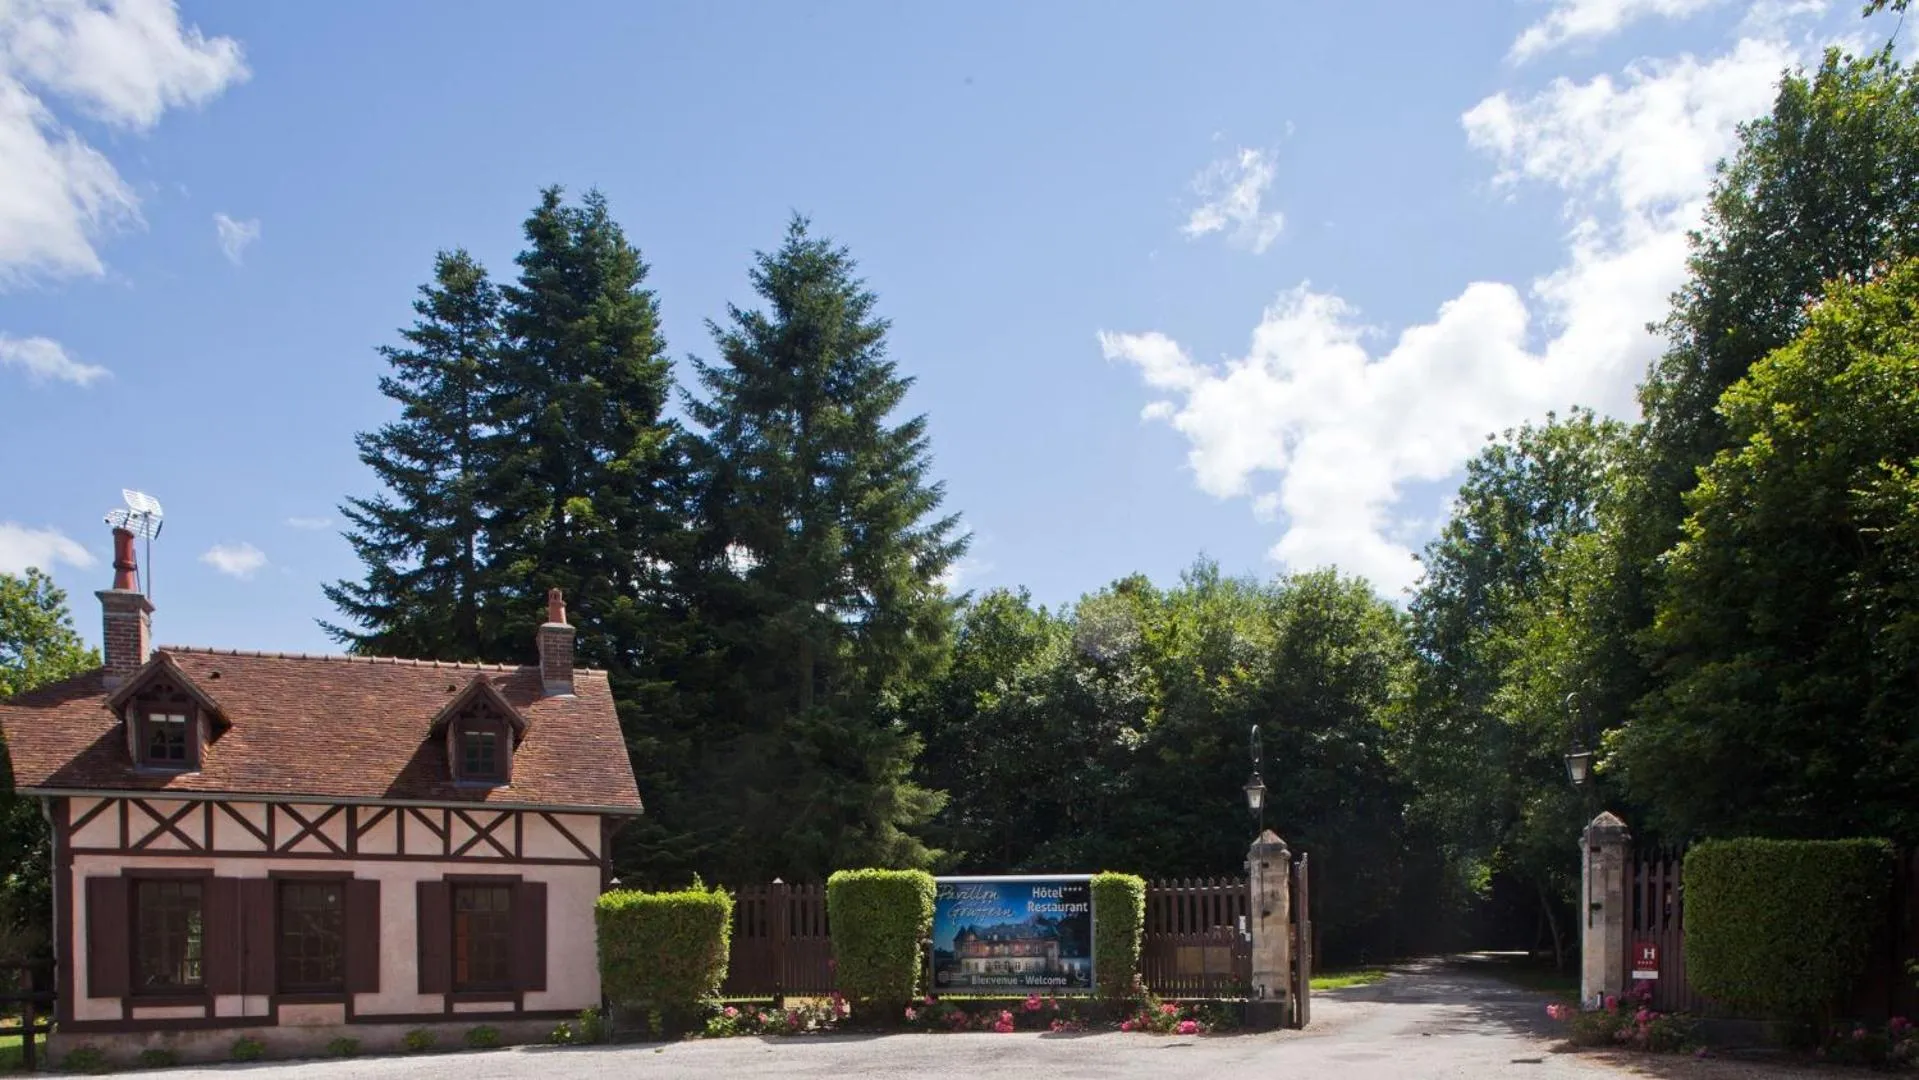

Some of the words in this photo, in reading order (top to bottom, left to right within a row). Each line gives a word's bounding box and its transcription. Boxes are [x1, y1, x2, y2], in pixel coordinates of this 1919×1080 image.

[1032, 886, 1064, 899] Hôtel
[1027, 901, 1089, 912] Restaurant
[1643, 948, 1655, 959] H
[971, 975, 1018, 985] Bienvenue
[1025, 975, 1067, 985] Welcome
